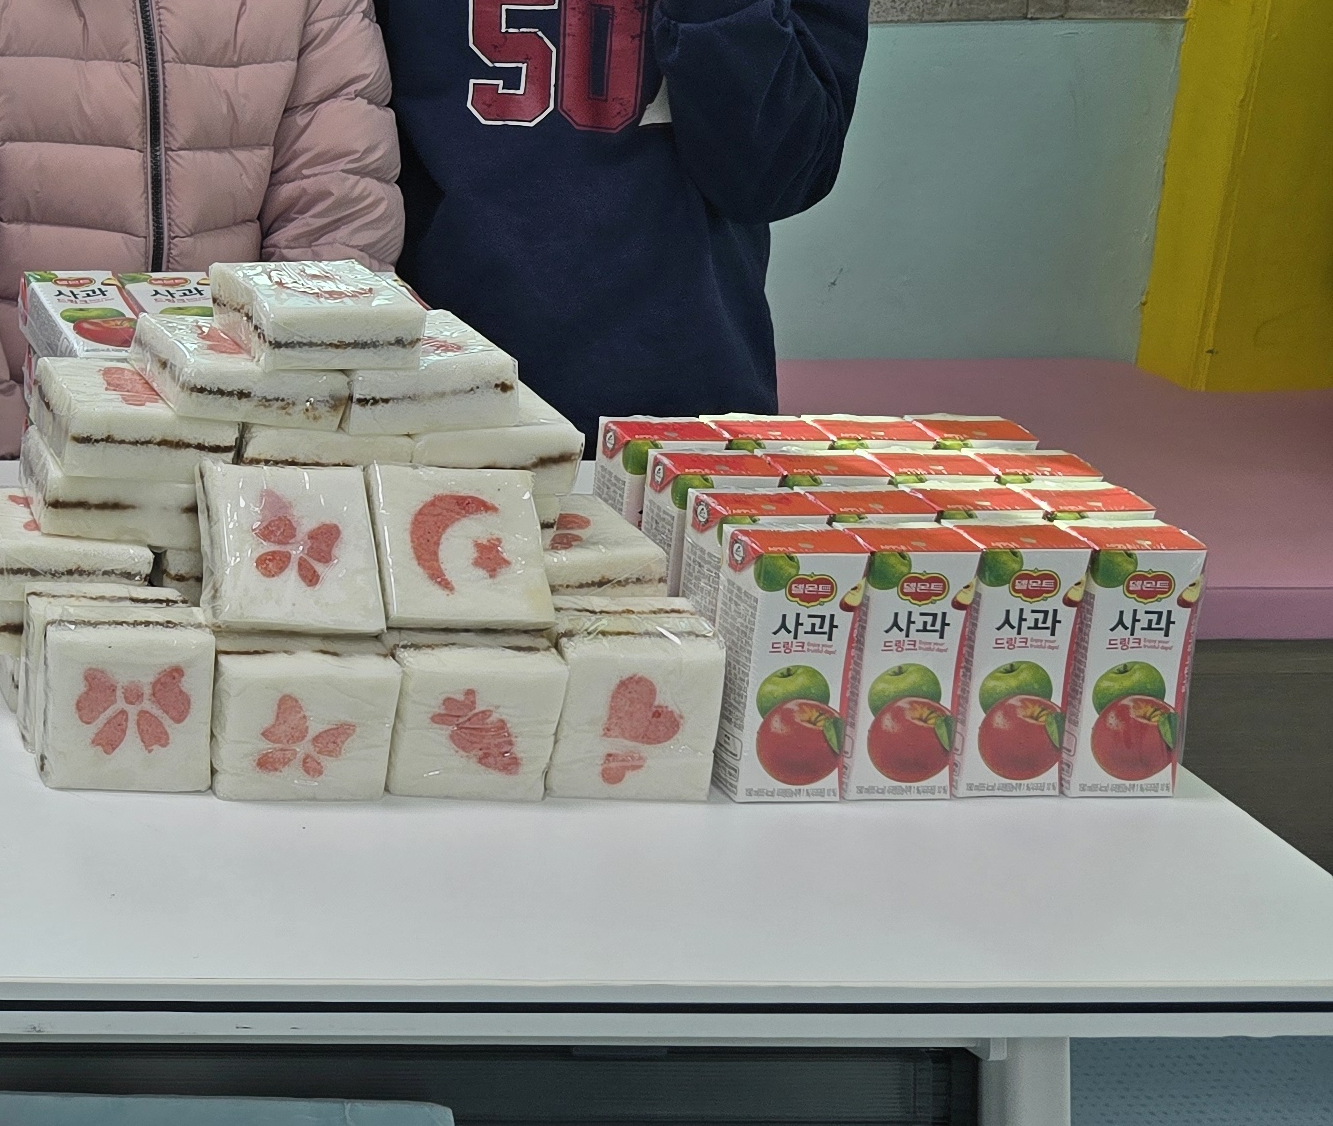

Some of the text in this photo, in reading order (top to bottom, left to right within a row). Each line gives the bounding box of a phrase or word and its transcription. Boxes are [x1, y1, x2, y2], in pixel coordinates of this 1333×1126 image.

[54, 287, 109, 300] 사과
[150, 287, 207, 299] 사과
[791, 583, 831, 595] 델몬트
[903, 582, 944, 594] 델몬트
[1014, 579, 1055, 590] 델몬트
[1128, 580, 1169, 591] 델몬트
[772, 612, 839, 641] 사과
[883, 610, 950, 639] 사과
[995, 608, 1062, 636] 사과
[1109, 608, 1176, 637] 사과
[769, 640, 806, 654] 드링크
[881, 639, 917, 652] 드링크
[992, 636, 1030, 650] 드링크
[1106, 637, 1143, 651] 드링크
